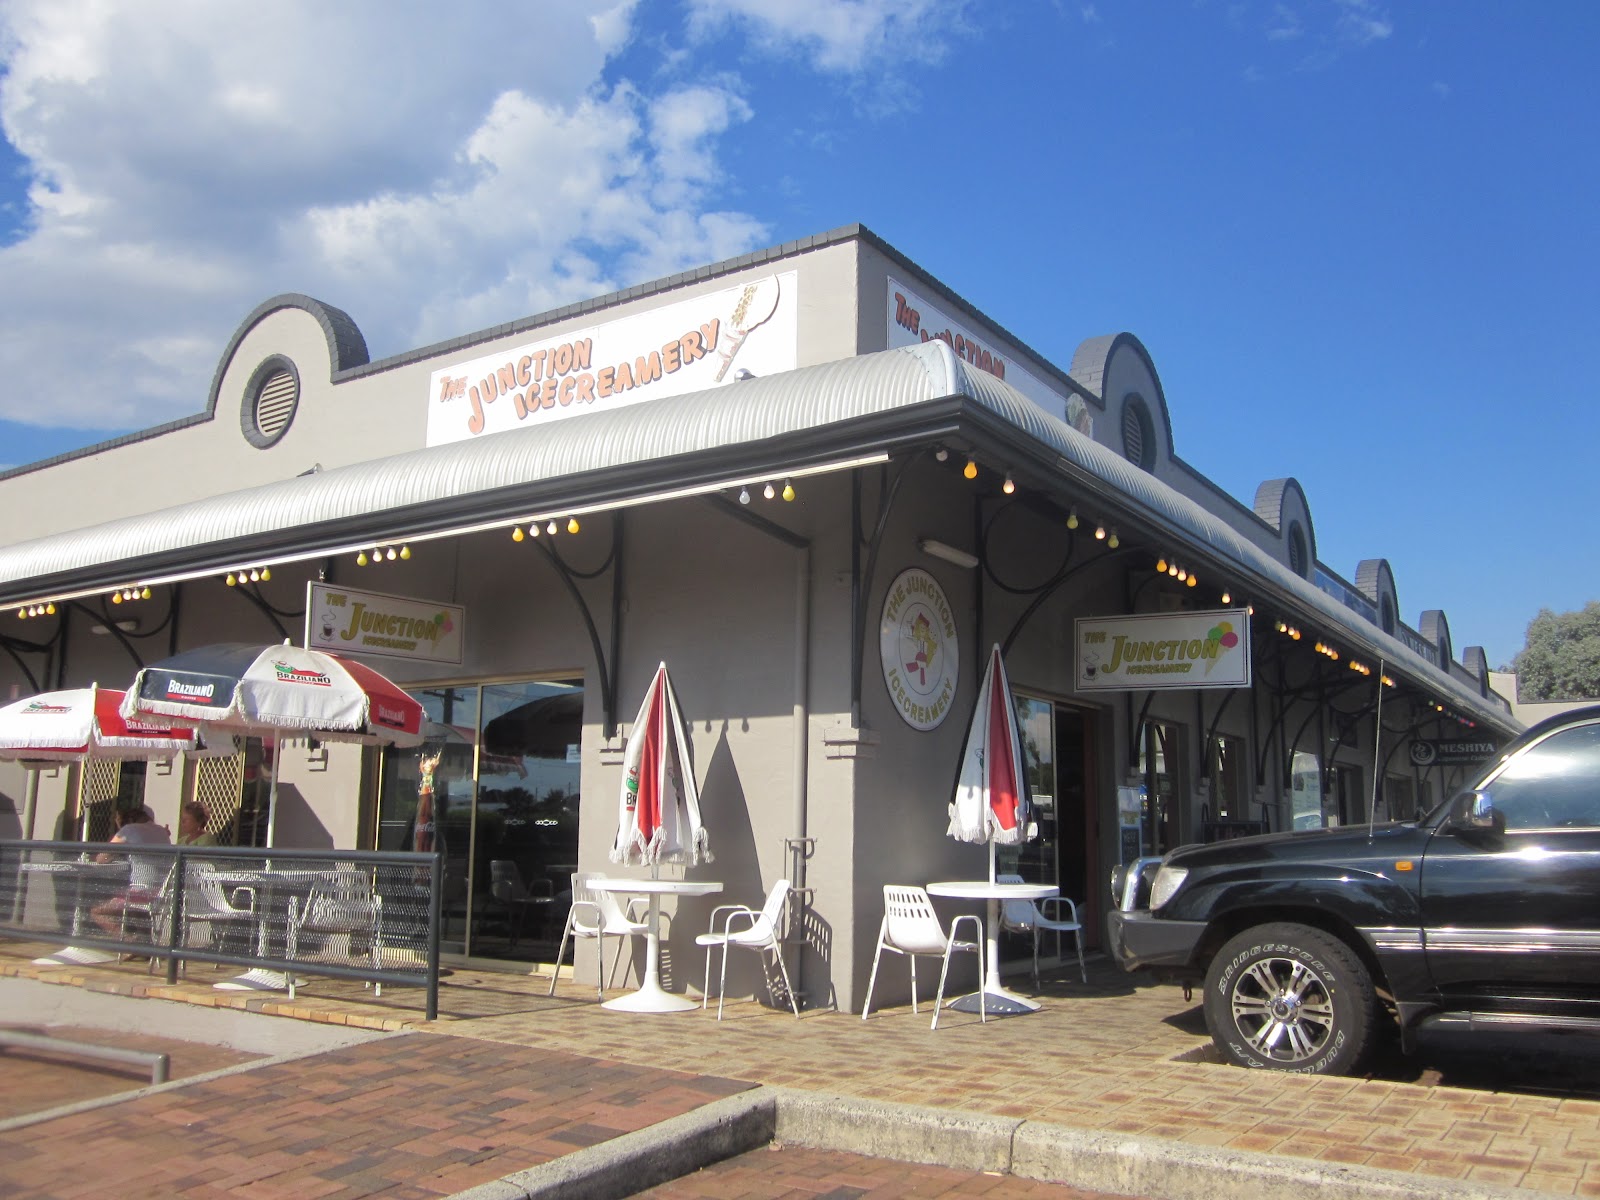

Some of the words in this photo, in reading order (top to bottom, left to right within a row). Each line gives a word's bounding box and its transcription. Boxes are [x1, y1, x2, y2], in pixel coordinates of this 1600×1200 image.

[894, 291, 920, 336] THE
[439, 375, 469, 402] THE
[468, 337, 592, 434] JUNCTION
[514, 318, 720, 420] ICECREAMERY
[326, 592, 347, 608] THE
[340, 602, 439, 641] JUNCTION
[886, 585, 906, 622] THE
[905, 576, 954, 639] JUNCTION
[1084, 631, 1107, 644] THE
[1102, 635, 1220, 673] JUNCTION
[167, 679, 215, 698] BRAZILIANO
[276, 671, 331, 684] BRAZILIANO
[888, 668, 953, 724] ICECREAMERY
[125, 719, 172, 731] BRAZILIANO
[1439, 743, 1495, 753] MESHIYA
[1218, 943, 1336, 996] BRIDGESTONE
